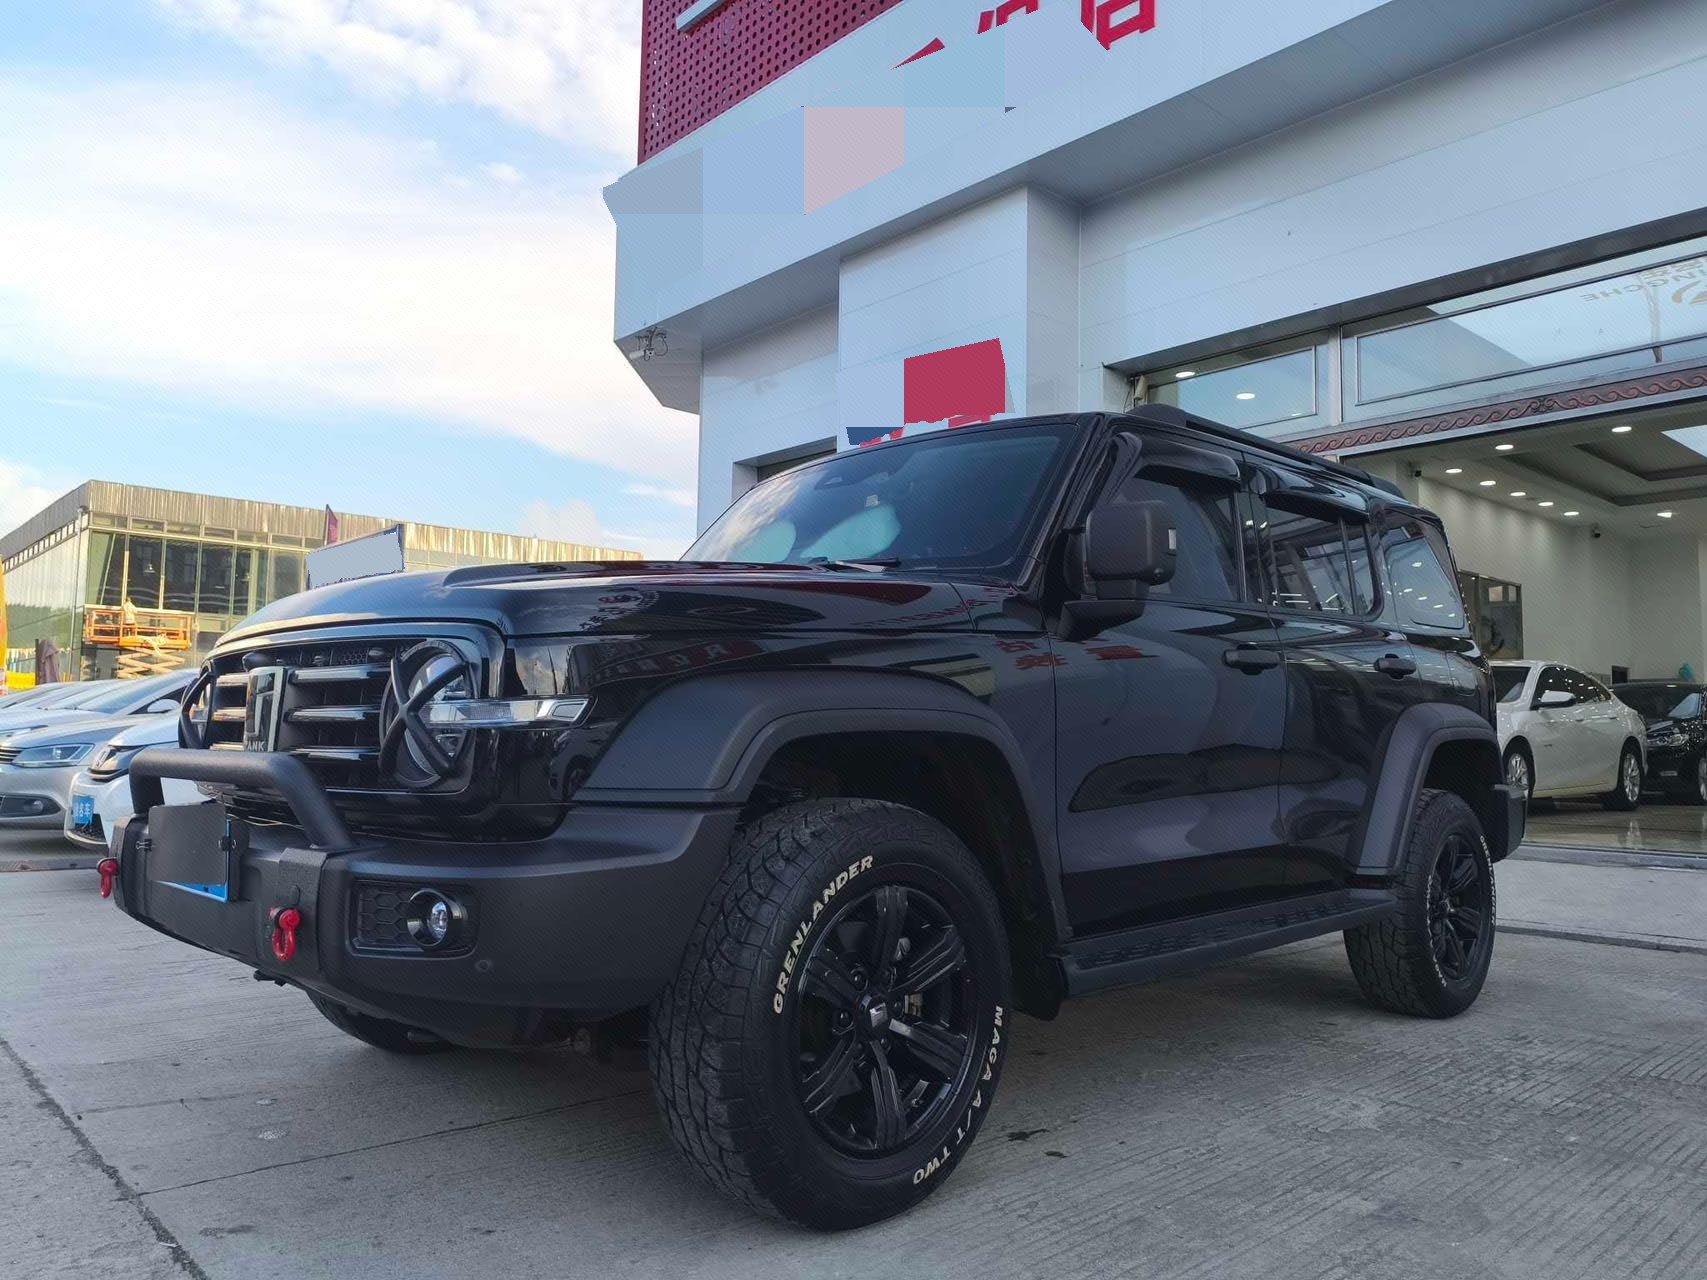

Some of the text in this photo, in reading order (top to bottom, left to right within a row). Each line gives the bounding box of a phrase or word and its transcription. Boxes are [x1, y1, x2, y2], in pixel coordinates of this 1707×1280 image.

[773, 854, 874, 1014] GRENLANDER
[913, 1005, 1004, 1185] MAGA A/T TWO
